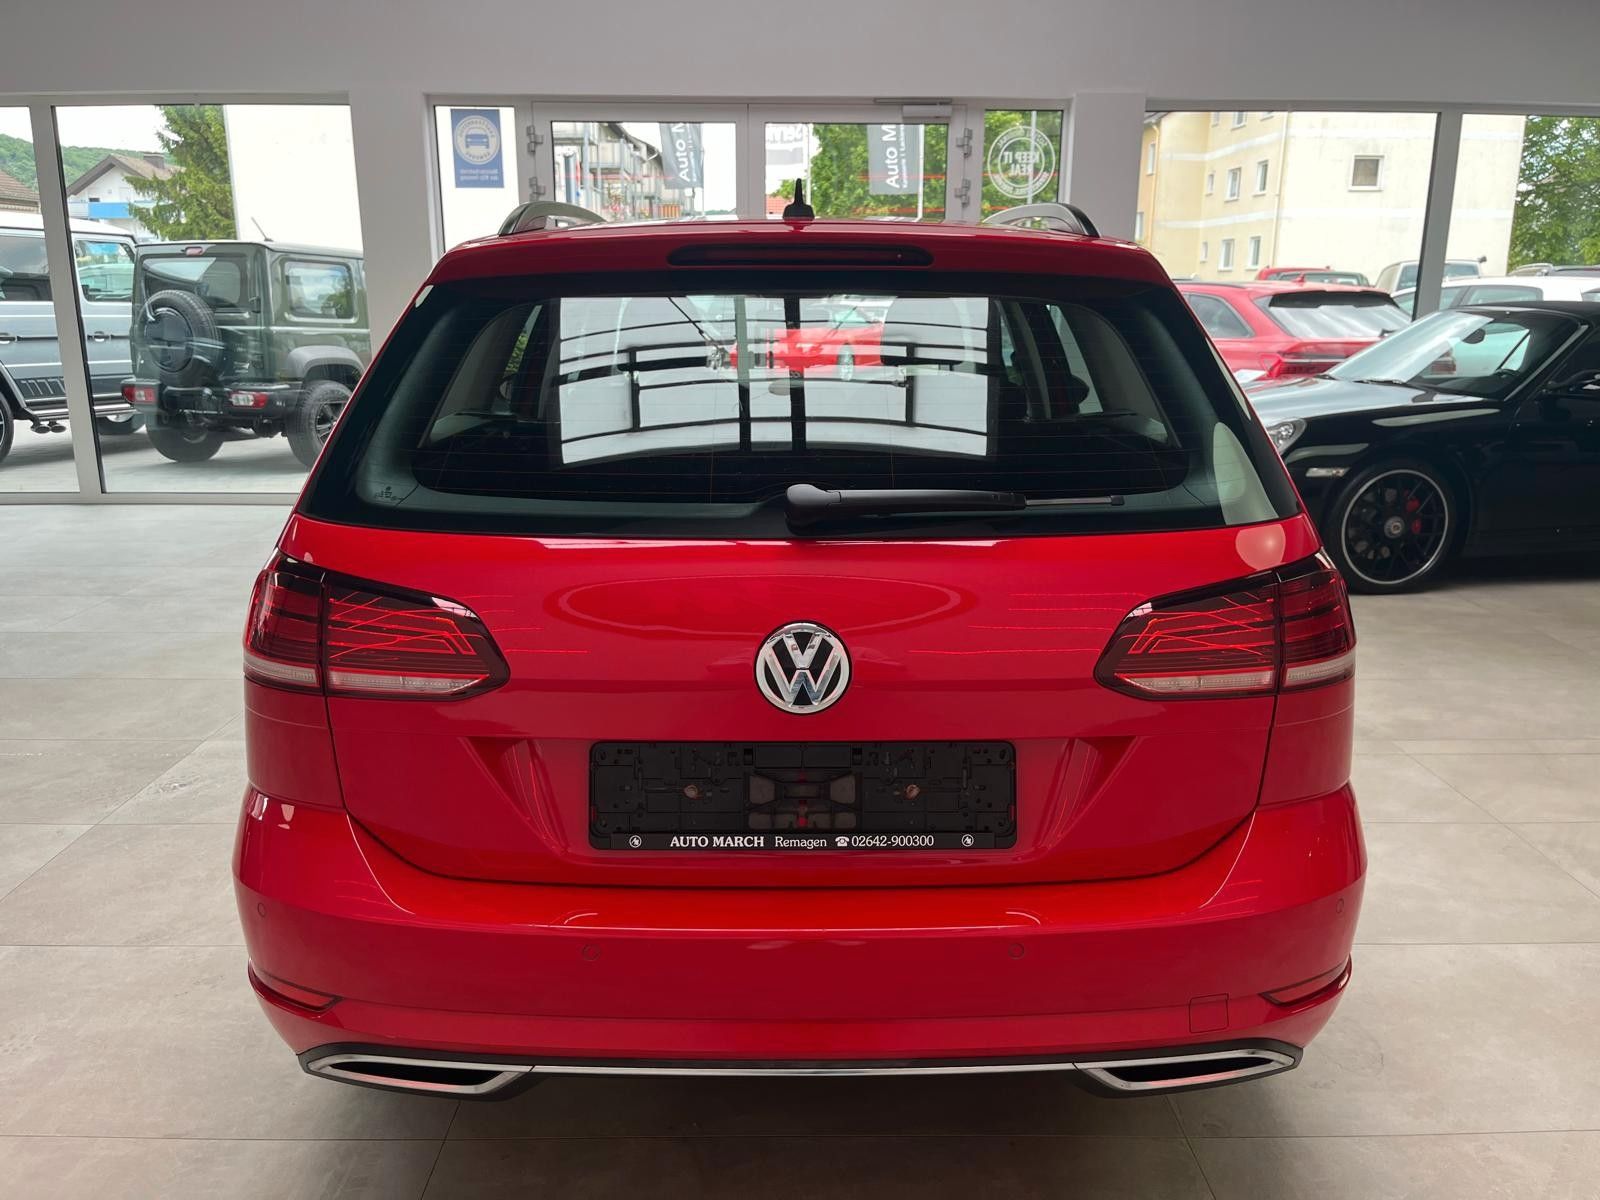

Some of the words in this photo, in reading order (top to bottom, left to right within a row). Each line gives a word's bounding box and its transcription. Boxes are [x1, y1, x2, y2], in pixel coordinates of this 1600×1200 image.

[676, 139, 690, 182] Auto
[885, 147, 899, 188] Auto
[670, 836, 709, 848] AUTO
[712, 836, 765, 848] MARCH
[775, 836, 827, 849] Remagen
[851, 835, 935, 847] 02642-900300
